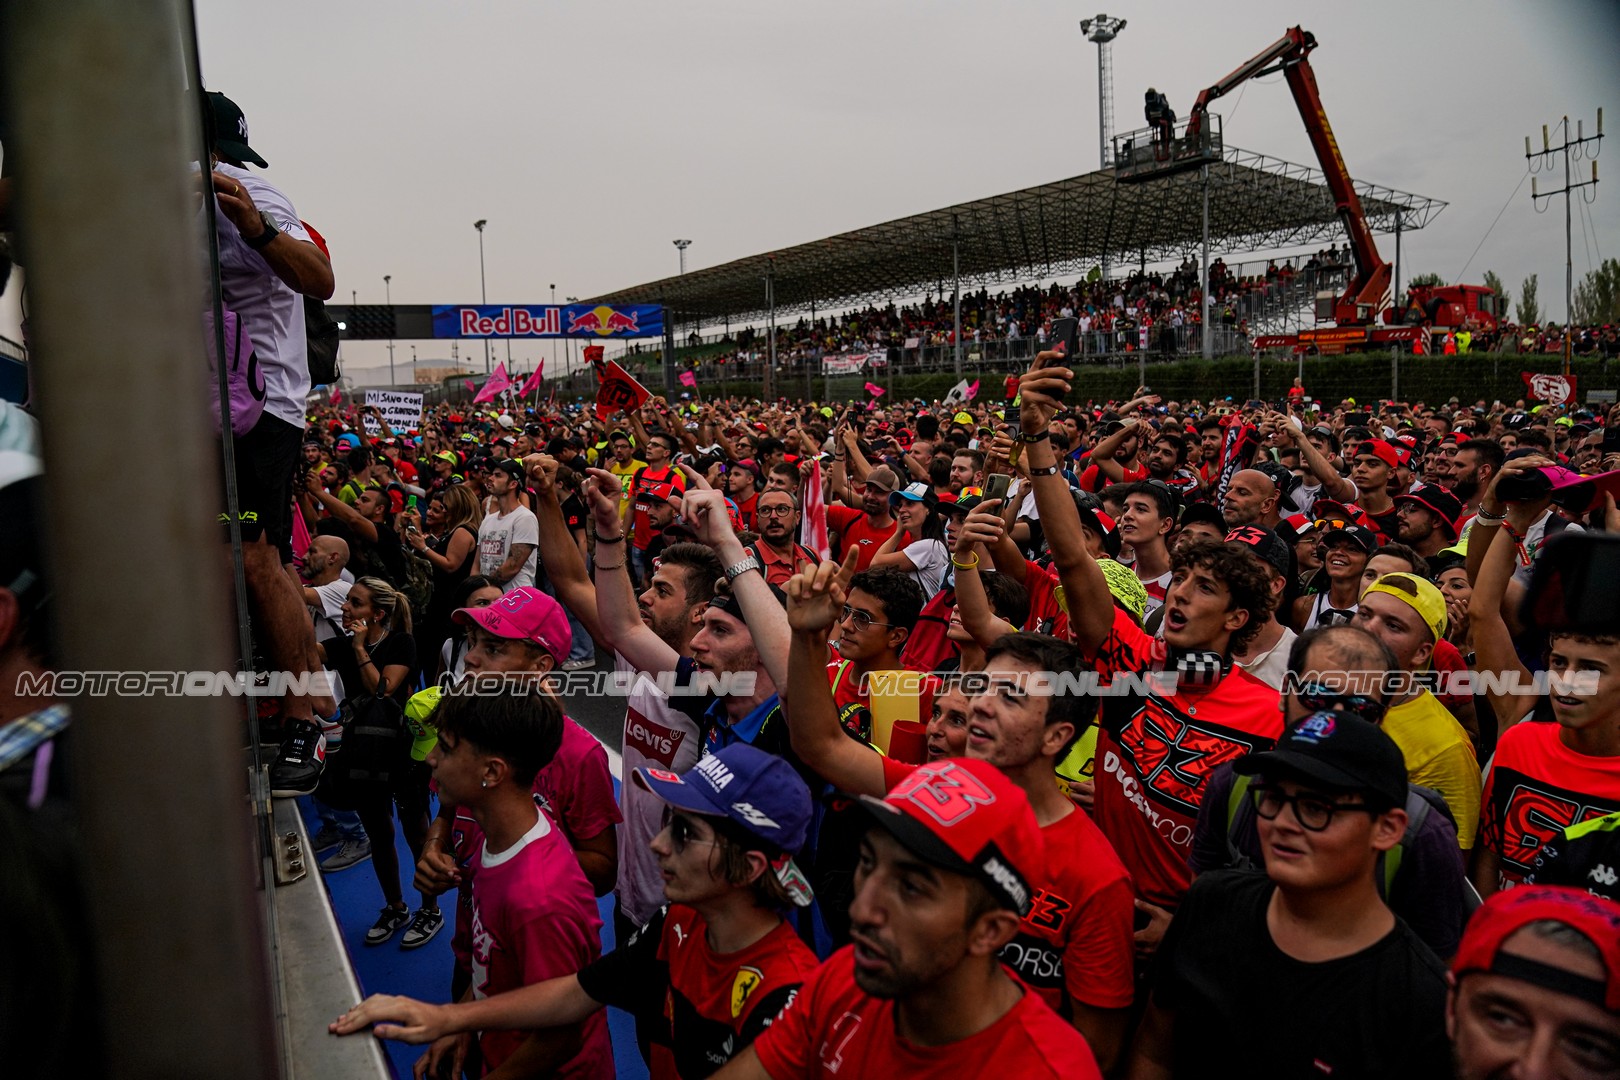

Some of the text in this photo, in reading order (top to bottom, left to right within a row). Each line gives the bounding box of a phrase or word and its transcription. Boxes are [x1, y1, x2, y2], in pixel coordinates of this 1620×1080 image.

[461, 307, 561, 335] Red Bull
[1223, 525, 1268, 546] 63
[1103, 750, 1160, 829] DUCATI
[997, 942, 1064, 978] ORSE
